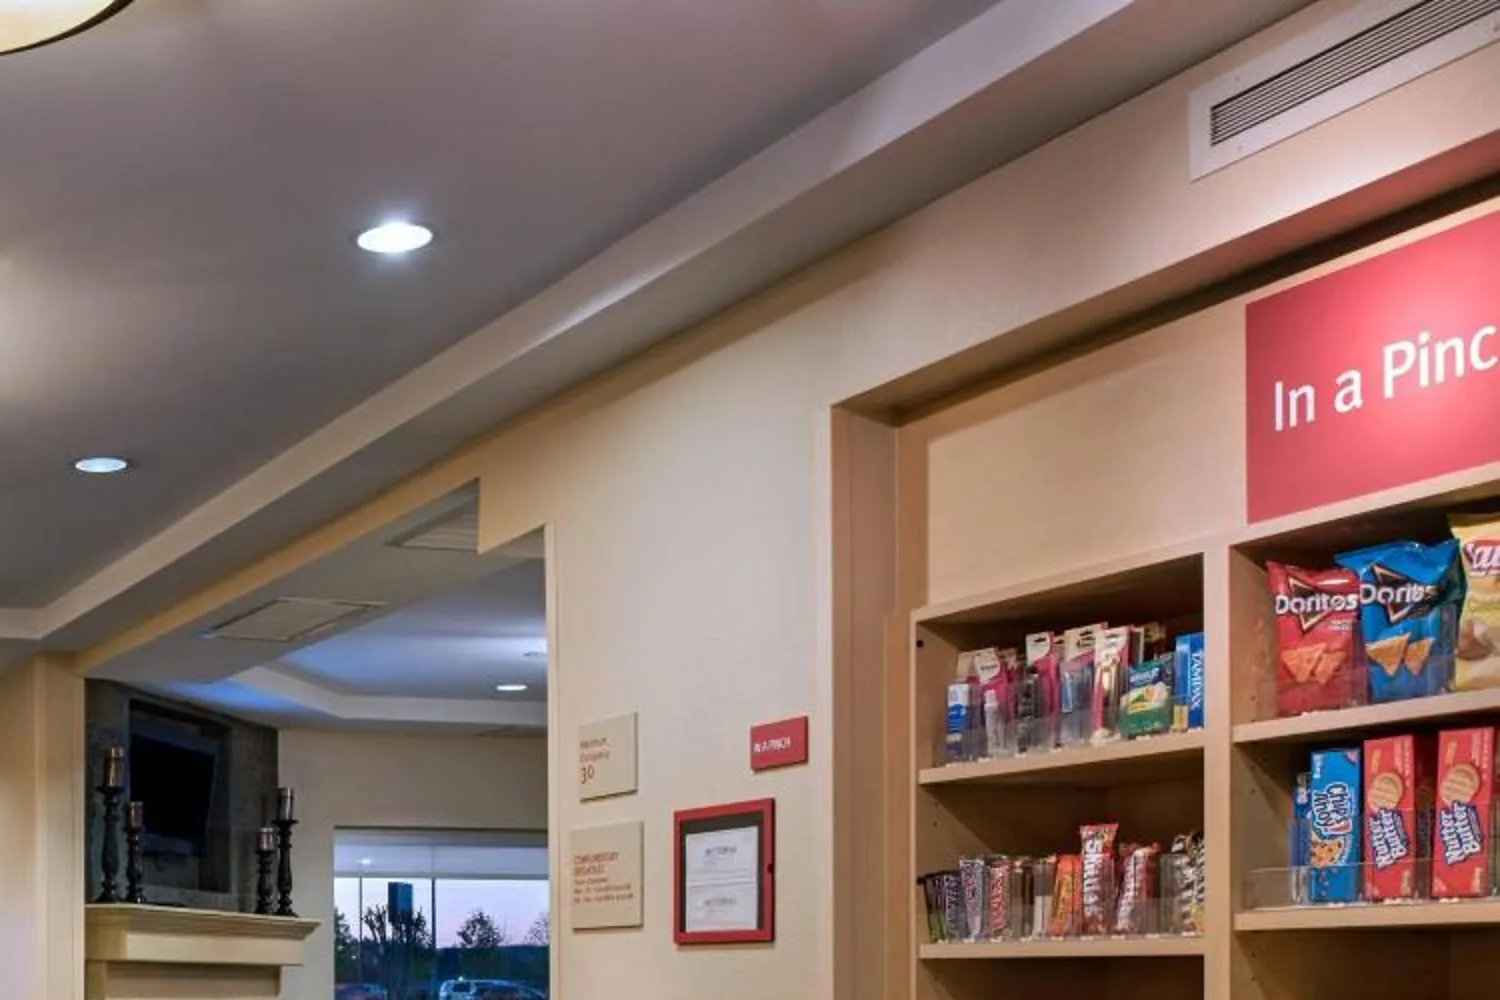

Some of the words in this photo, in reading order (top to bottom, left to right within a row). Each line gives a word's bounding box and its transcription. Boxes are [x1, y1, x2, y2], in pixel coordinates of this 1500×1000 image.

[1274, 381, 1315, 431] In
[1333, 368, 1364, 413] a
[1382, 324, 1499, 399] Pinc
[1275, 592, 1359, 615] Doritos
[1326, 782, 1350, 824] Chips
[1453, 801, 1481, 854] Butter
[1368, 816, 1394, 868] Nutter
[1379, 809, 1407, 859] Butter
[1439, 809, 1464, 864] Nutter
